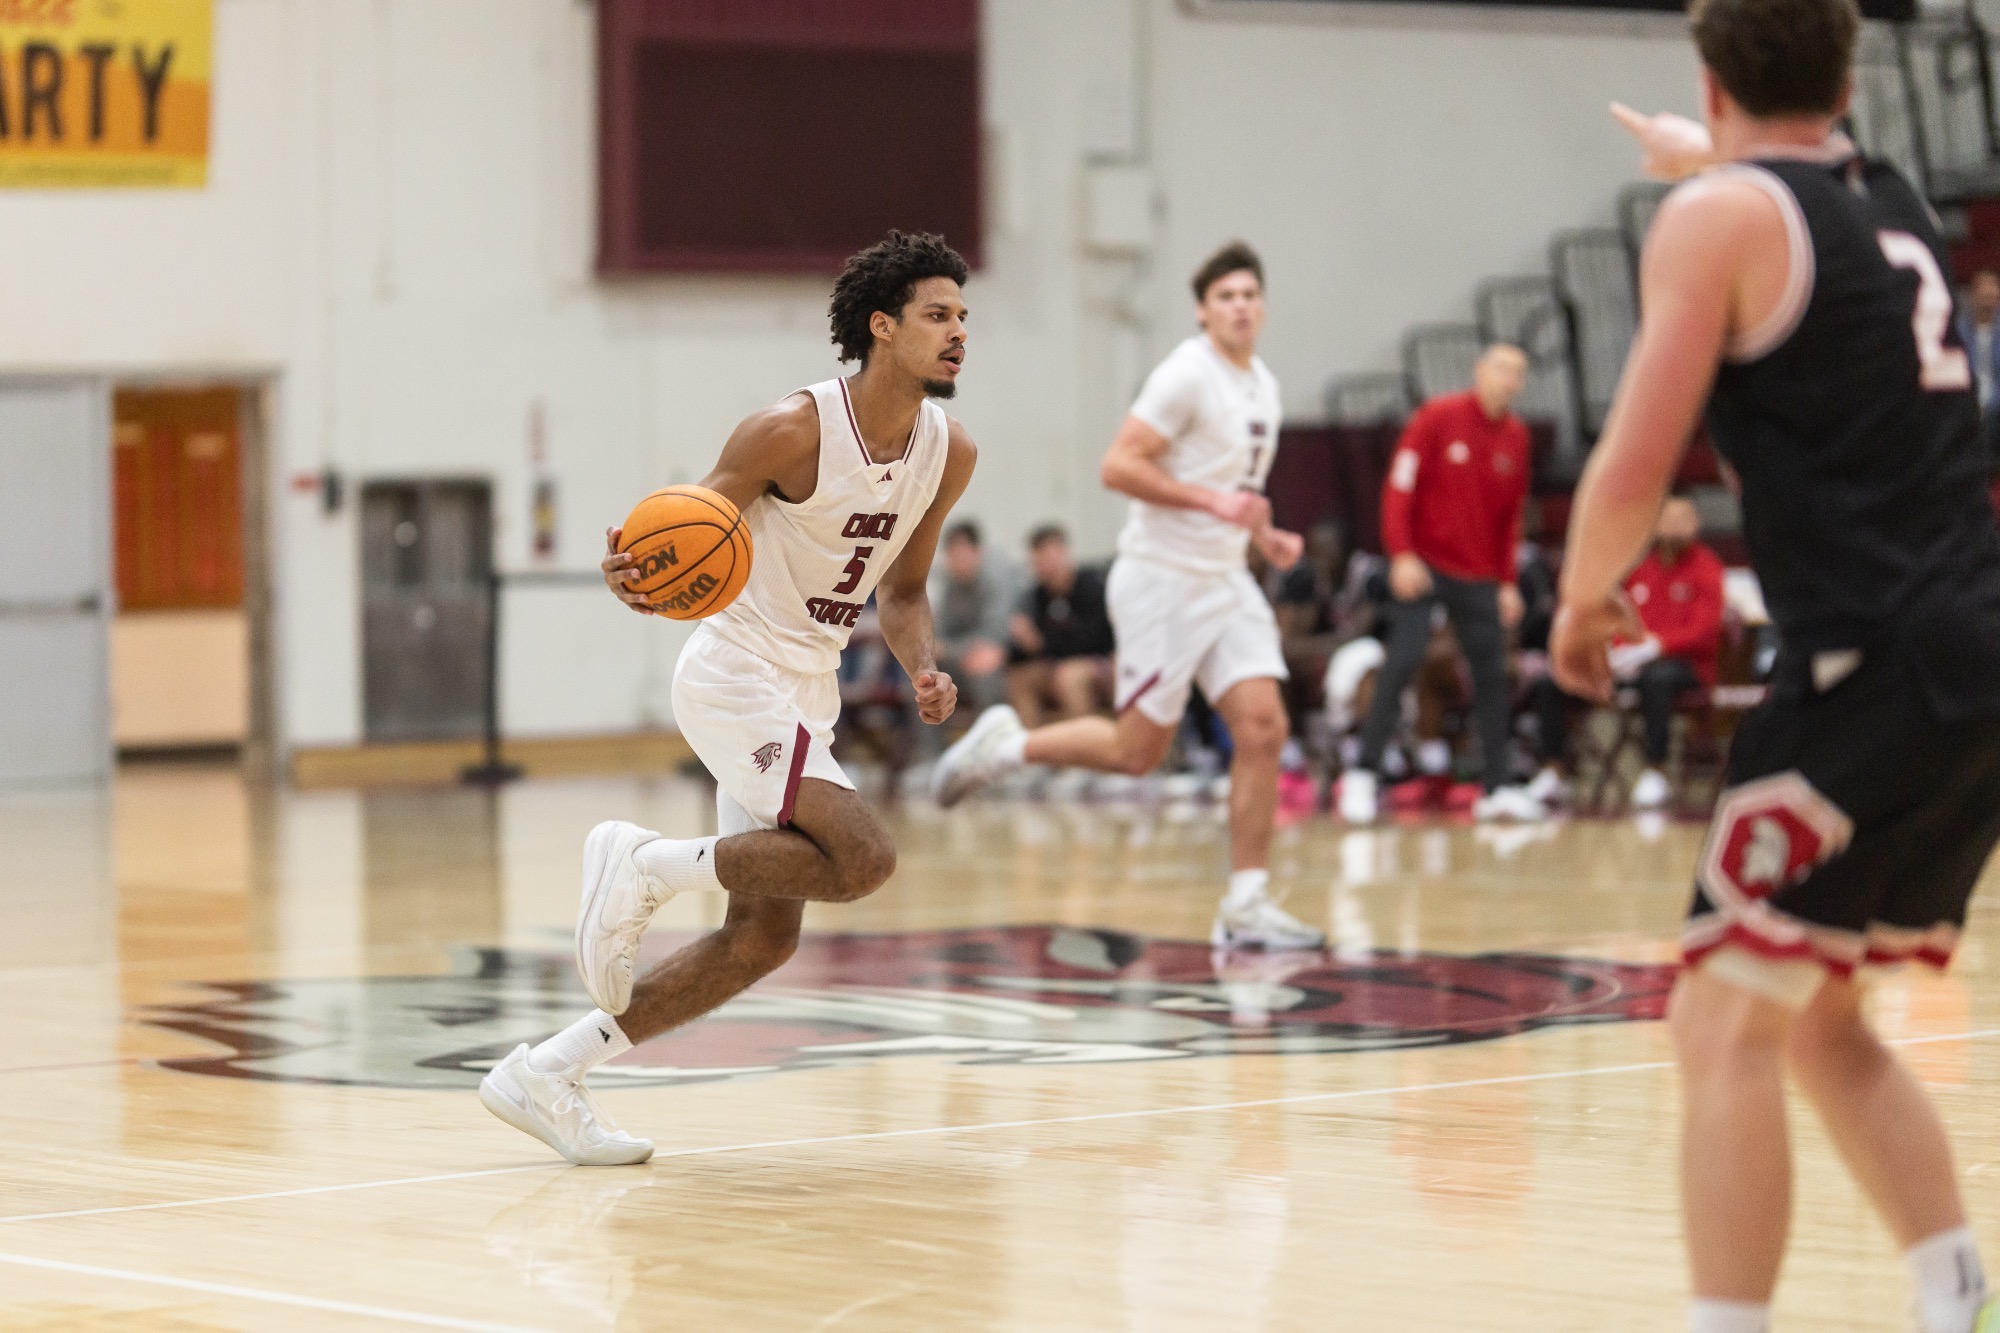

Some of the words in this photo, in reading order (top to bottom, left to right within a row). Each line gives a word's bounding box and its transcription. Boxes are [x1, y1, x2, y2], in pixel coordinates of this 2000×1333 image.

[0, 40, 175, 143] RTY
[1875, 229, 1971, 391] 2
[841, 512, 899, 541] CHICO
[632, 544, 679, 586] NCA
[831, 546, 874, 594] 5
[652, 572, 721, 612] Wilso
[805, 597, 865, 628] STATE
